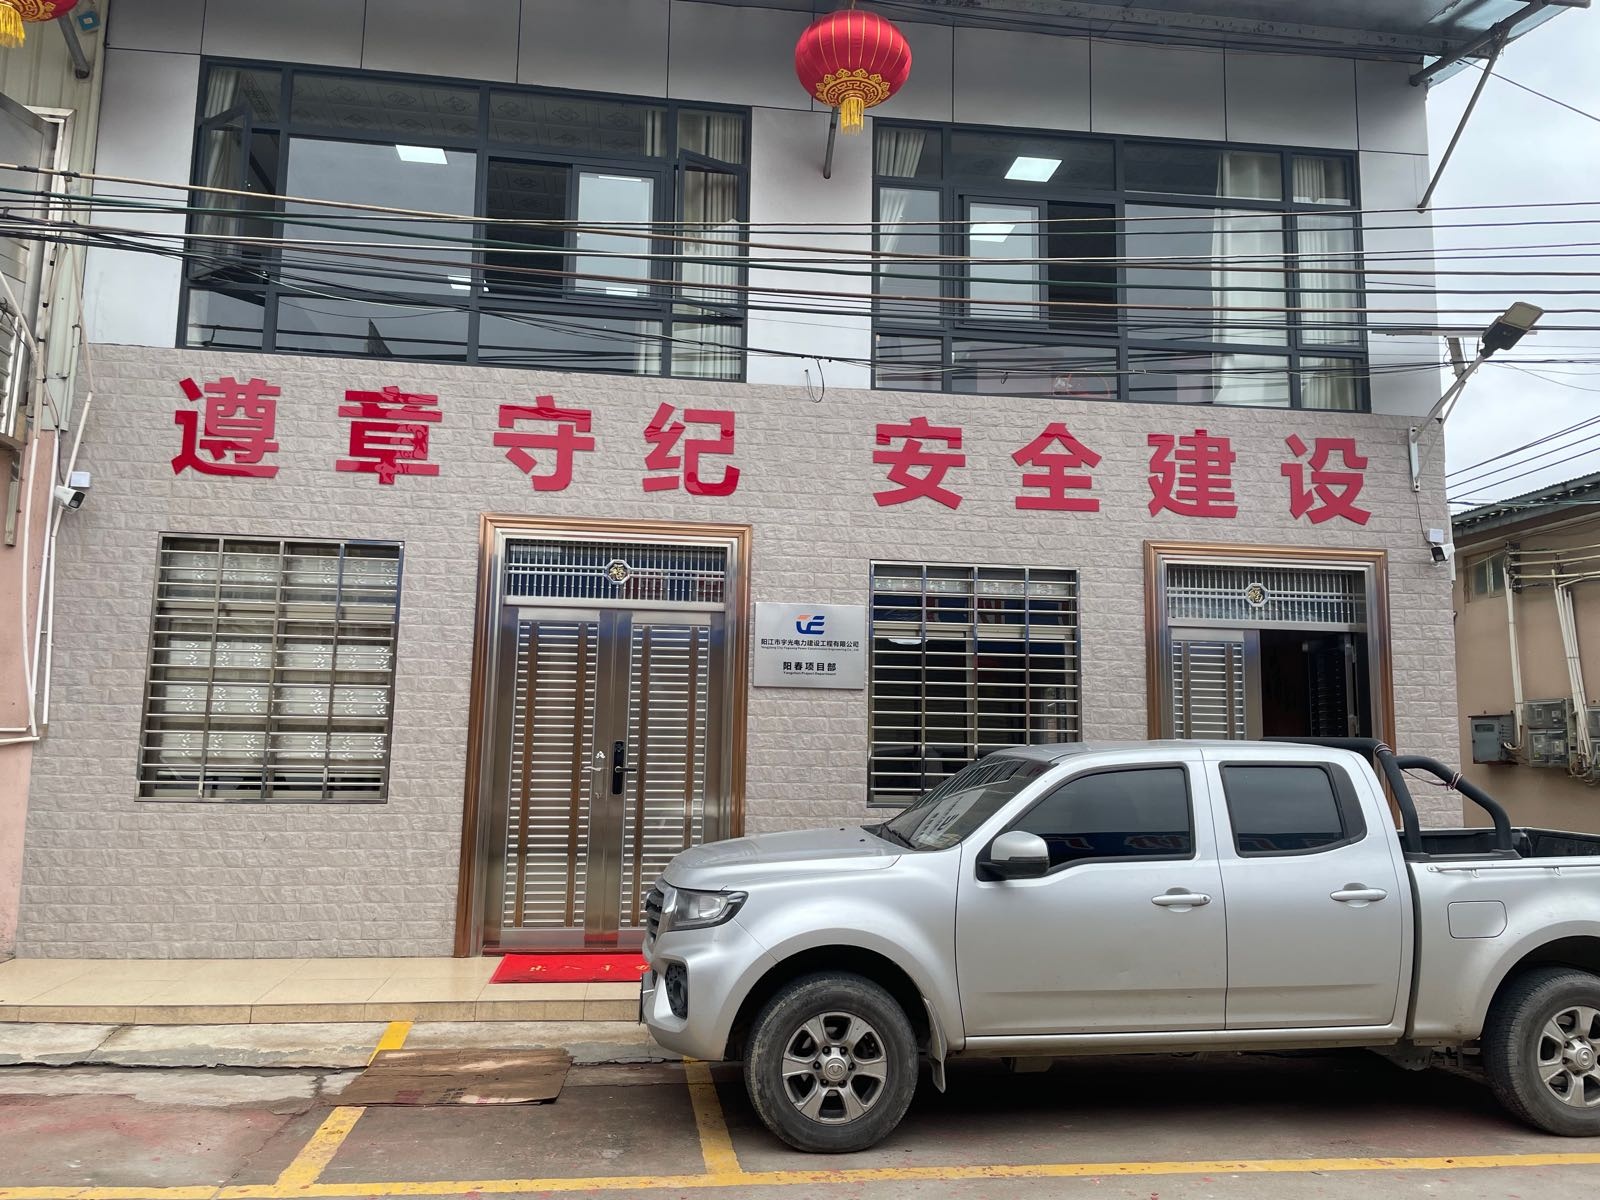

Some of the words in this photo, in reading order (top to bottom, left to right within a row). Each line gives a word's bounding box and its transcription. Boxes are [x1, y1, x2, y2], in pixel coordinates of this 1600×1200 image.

[171, 377, 740, 497] 遵章守纪
[873, 417, 1370, 525] 安全建设
[760, 638, 860, 648] 阳江市宇光电力建设工程有限公司
[783, 661, 837, 672] 阳春项目部
